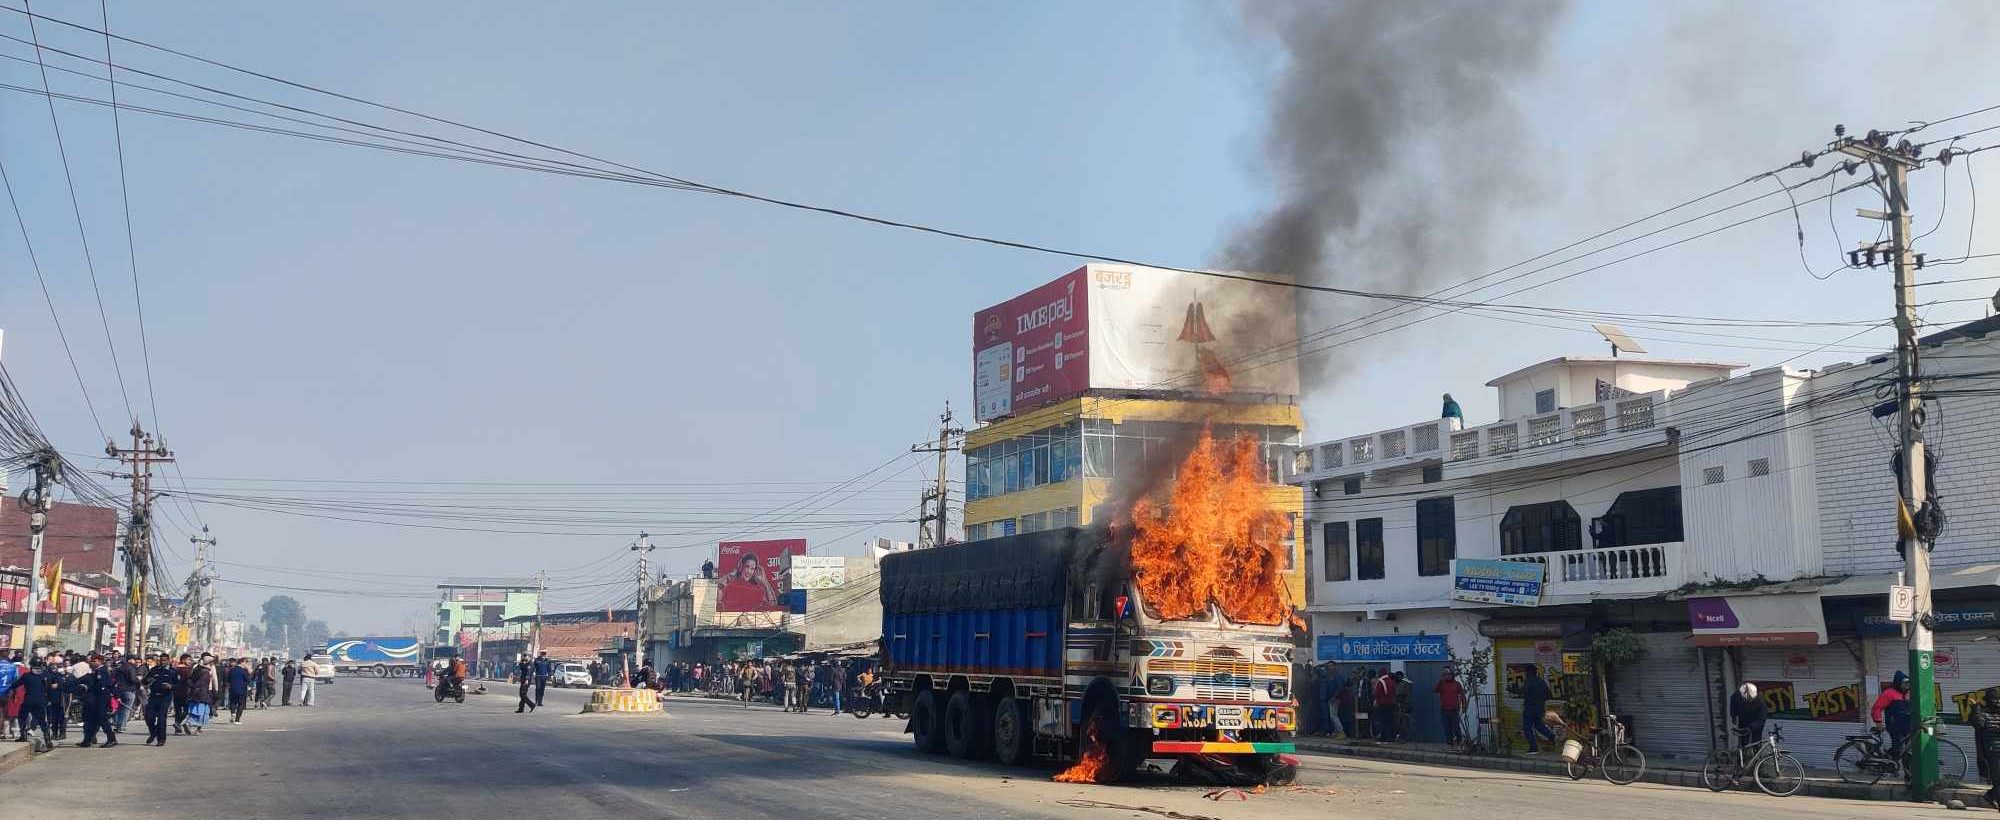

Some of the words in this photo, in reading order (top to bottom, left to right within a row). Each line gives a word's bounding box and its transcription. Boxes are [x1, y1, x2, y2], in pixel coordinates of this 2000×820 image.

[1706, 614, 1724, 622] Ncell
[1353, 641, 1370, 656] शिव
[1373, 640, 1410, 656] मेडिकल
[1413, 640, 1441, 656] सेन्टर
[1803, 684, 1860, 719] TASTY
[1241, 707, 1277, 729] KING
